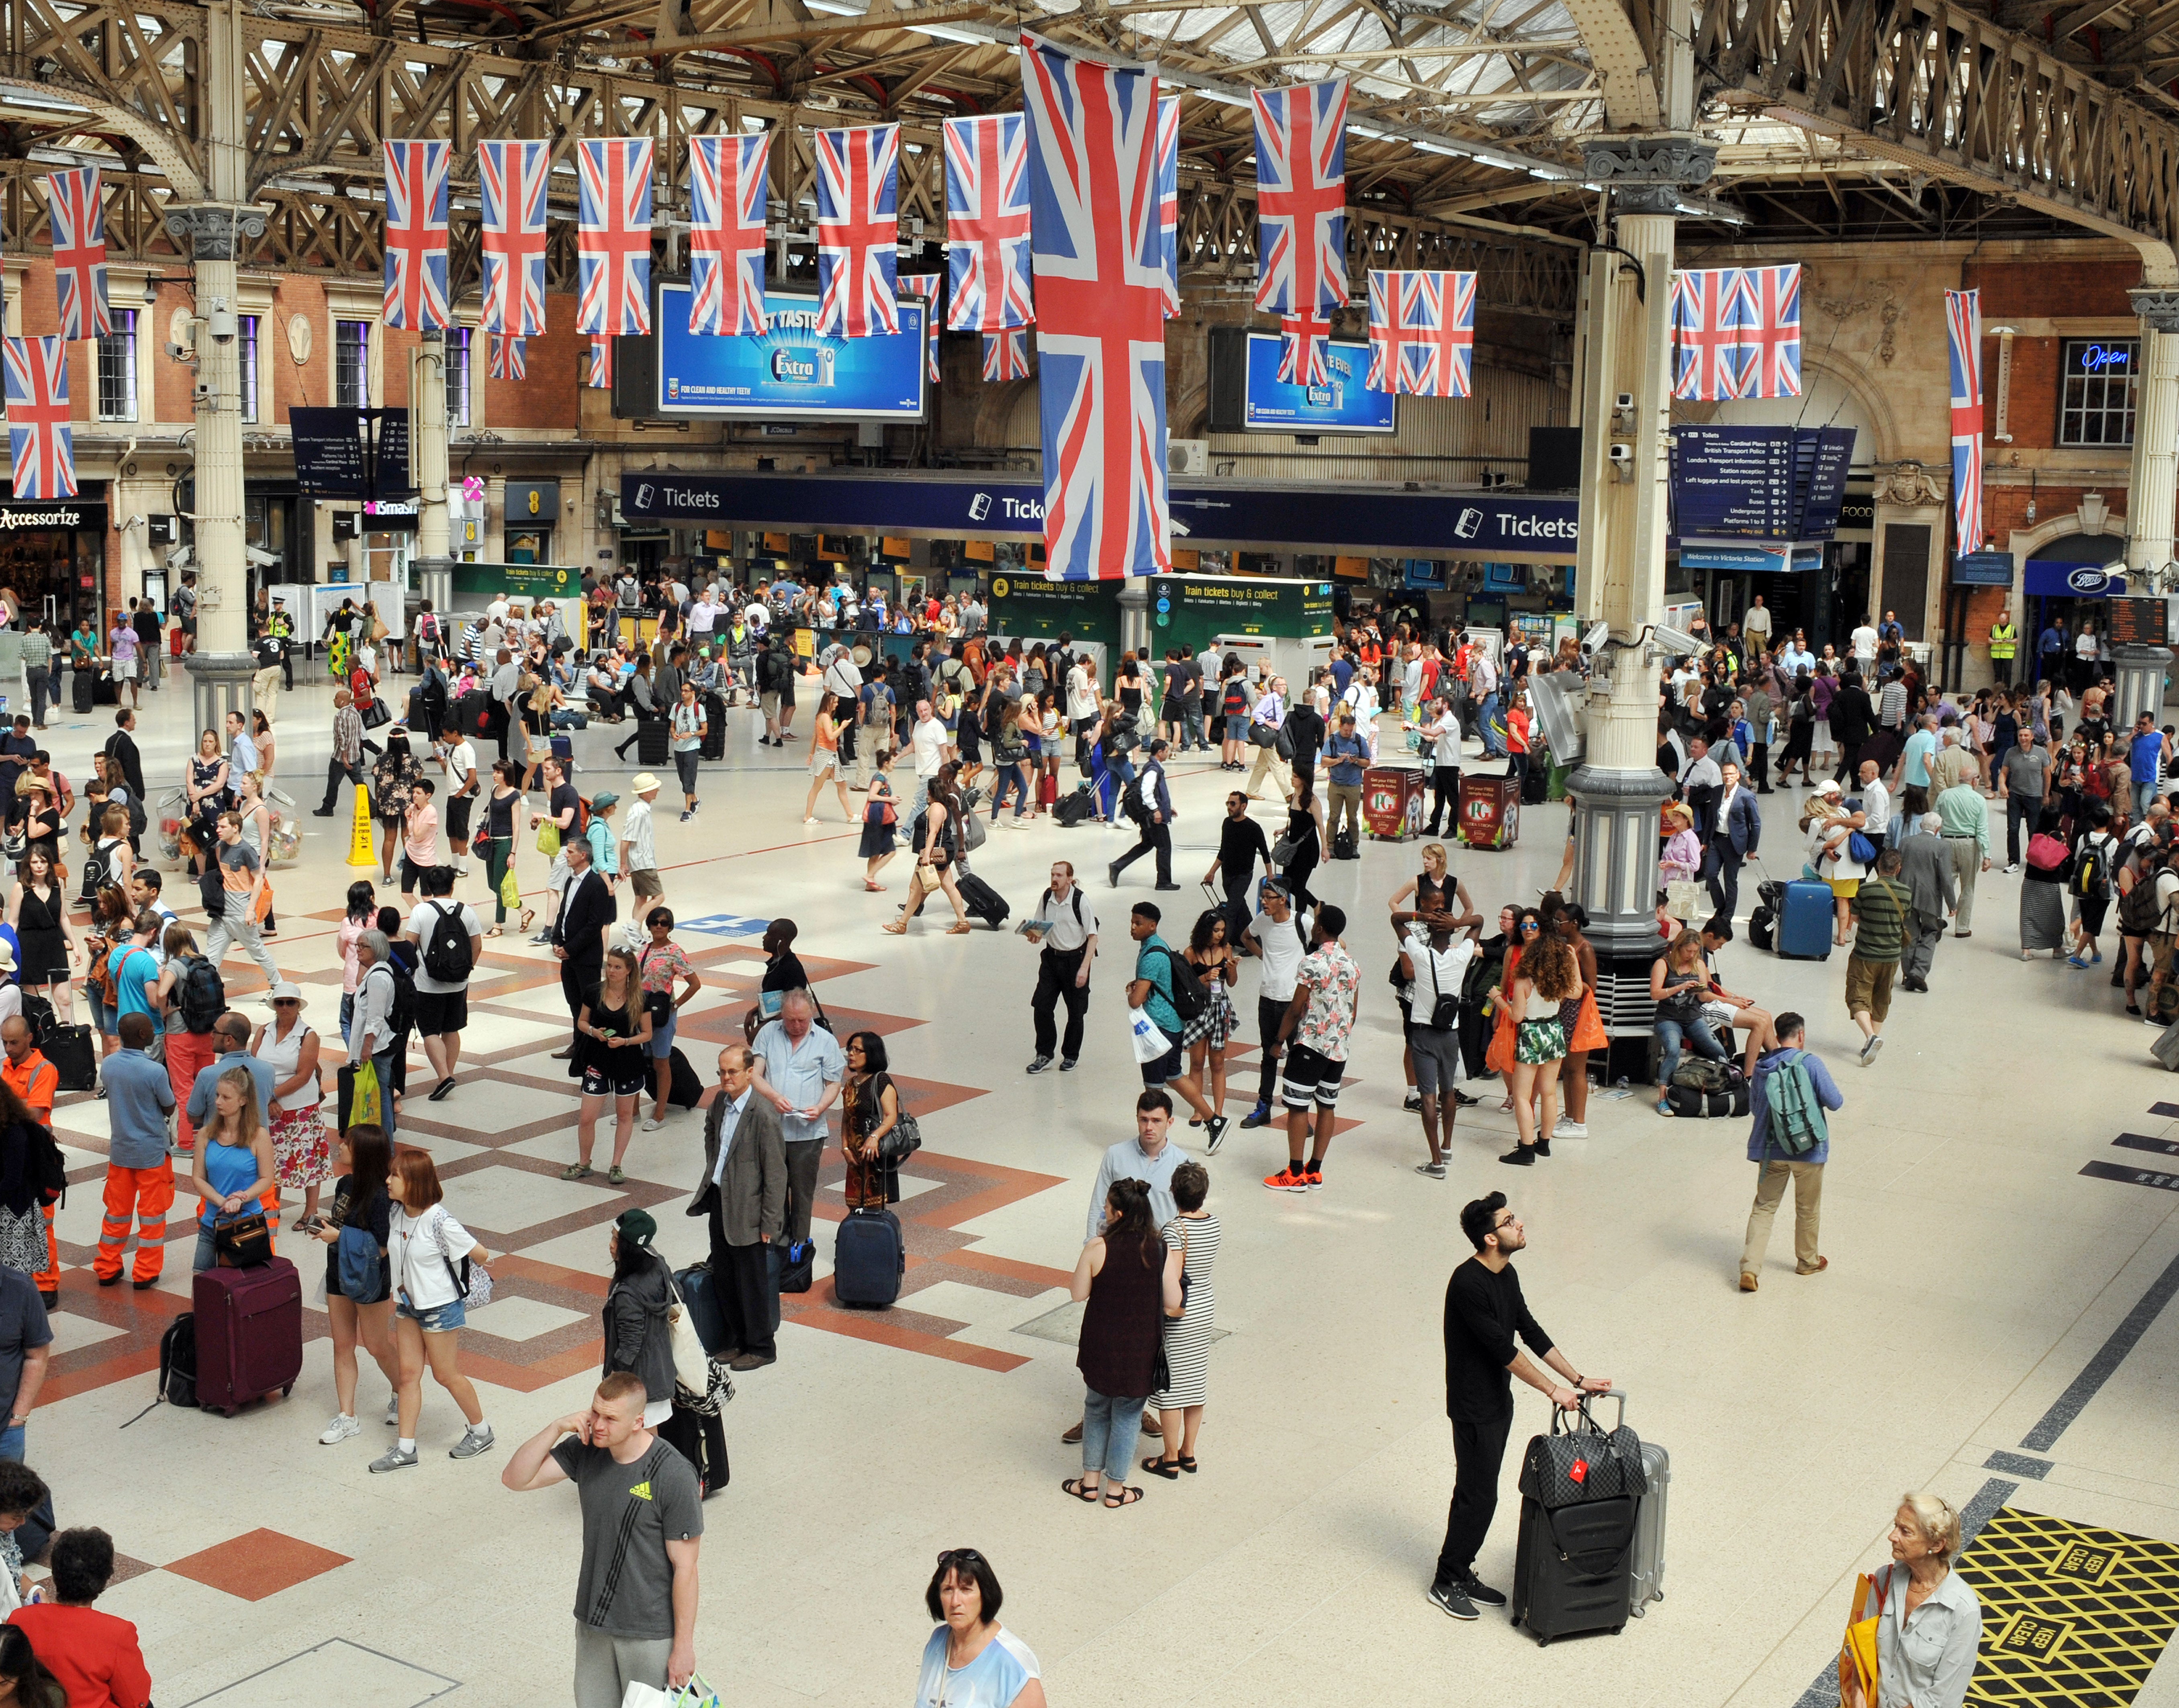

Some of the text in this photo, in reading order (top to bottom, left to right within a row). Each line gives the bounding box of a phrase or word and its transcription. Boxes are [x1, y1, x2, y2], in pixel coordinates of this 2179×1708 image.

[779, 310, 819, 329] TASTE
[776, 354, 814, 375] Extra
[2082, 345, 2128, 371] Open
[691, 386, 705, 394] CLEAN
[736, 387, 751, 395] TEETH
[1309, 386, 1331, 402] Extra
[663, 488, 720, 508] Tickets
[0, 506, 80, 530] Accessorize
[1002, 498, 1044, 519] Tick
[1842, 507, 1873, 517] FOOD
[1496, 513, 1578, 539] Tickets
[1013, 580, 1099, 594] Train tickets buy & collect
[2073, 573, 2102, 587] Boots
[1184, 585, 1279, 600] Train tickets buy & collect
[270, 642, 279, 653] 3
[1376, 794, 1393, 810] PG
[1471, 802, 1490, 818] PG
[630, 1488, 653, 1501] adidas
[2061, 1549, 2089, 1572] CLEAR
[2082, 1554, 2107, 1574] KEEP
[2007, 1620, 2038, 1647] CLEAR
[2031, 1627, 2056, 1649] KEEP
